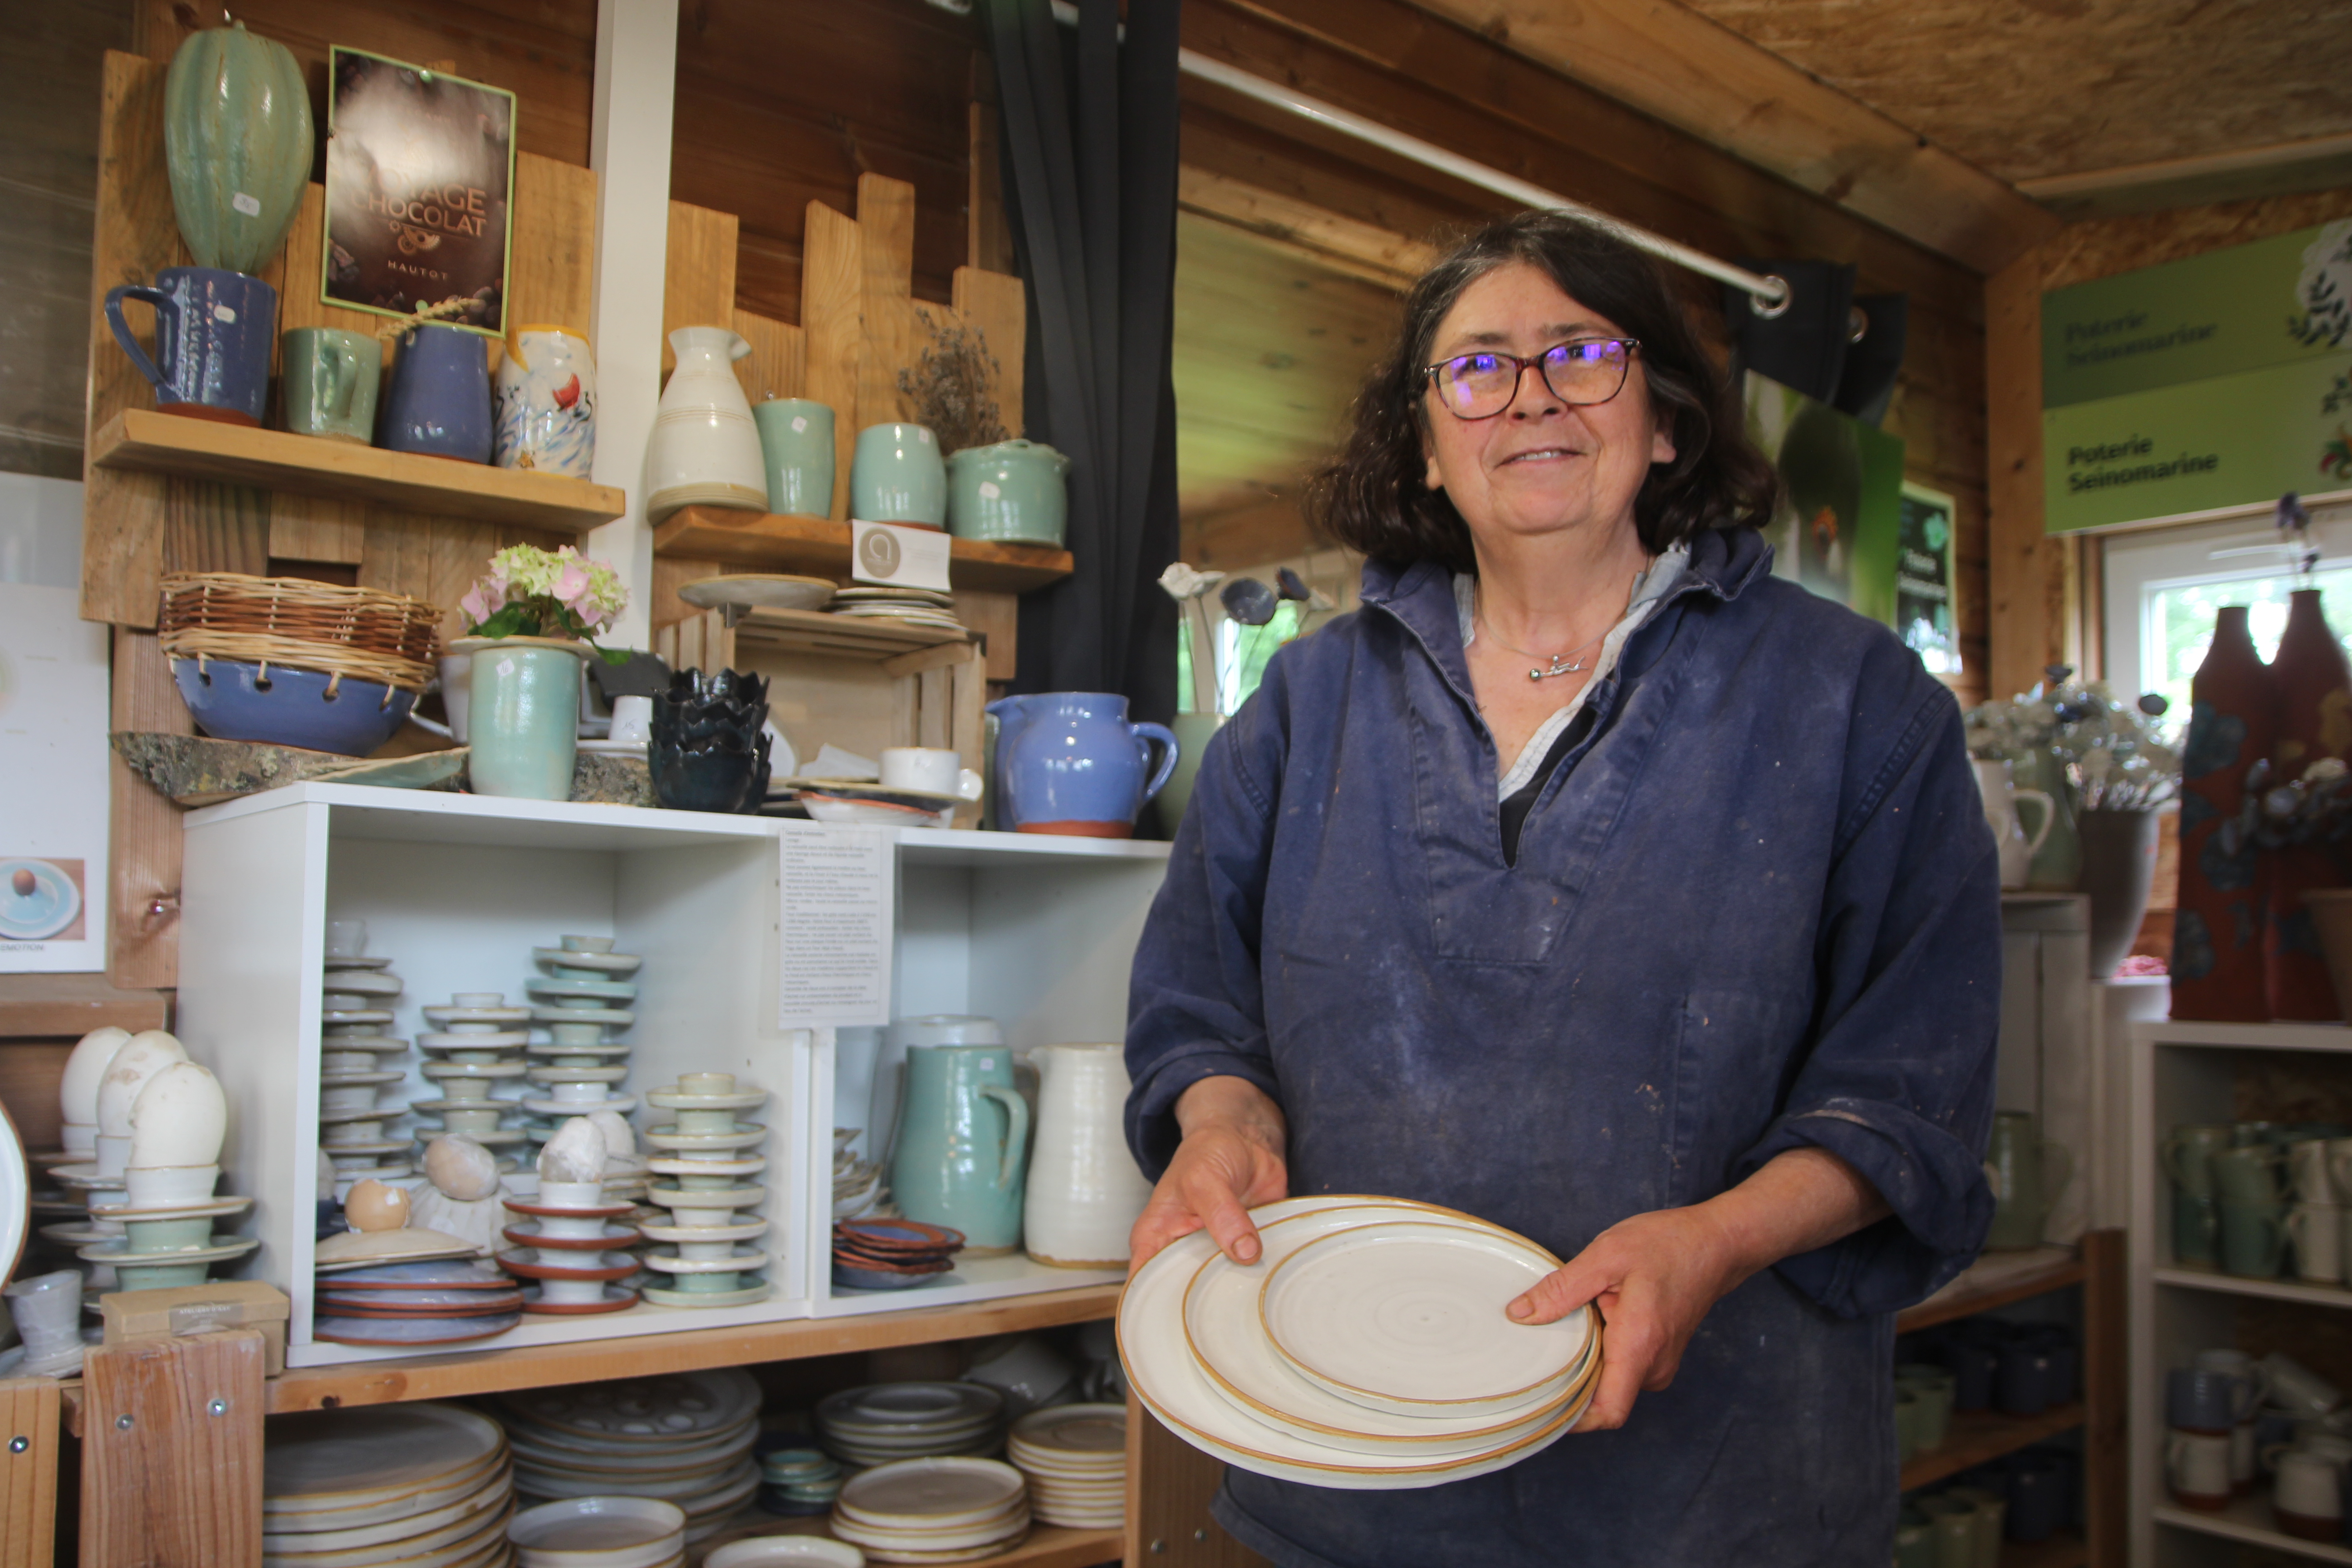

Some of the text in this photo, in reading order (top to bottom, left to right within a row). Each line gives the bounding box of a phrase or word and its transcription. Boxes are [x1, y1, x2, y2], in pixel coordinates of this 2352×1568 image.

[351, 189, 486, 237] CHOCOLAT
[388, 260, 448, 280] HAUTOT
[2069, 432, 2153, 466] Poterie
[2069, 451, 2219, 494] Seinomarine
